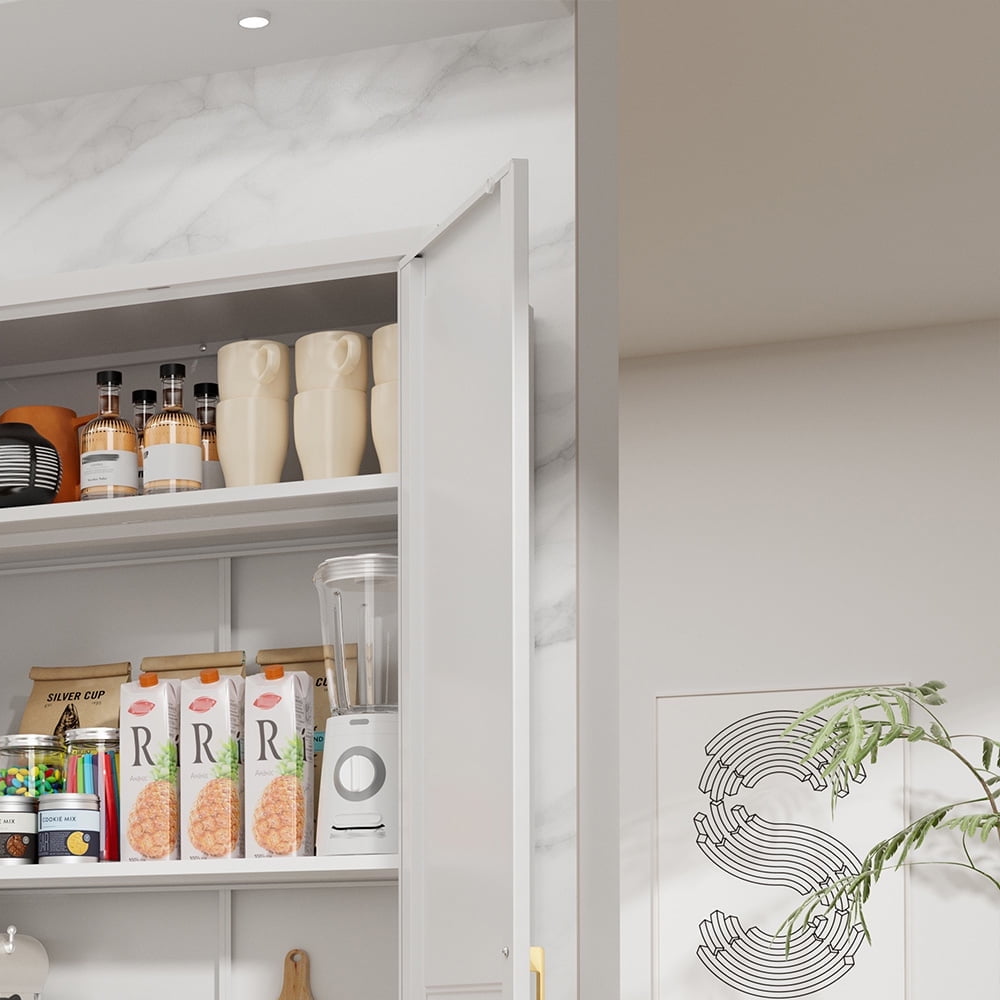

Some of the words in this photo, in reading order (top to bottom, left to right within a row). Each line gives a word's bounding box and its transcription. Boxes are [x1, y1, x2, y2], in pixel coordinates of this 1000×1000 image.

[47, 691, 81, 702] SILVER
[83, 690, 106, 700] CUP
[130, 726, 156, 767] R
[191, 723, 217, 764] R
[256, 719, 283, 761] R
